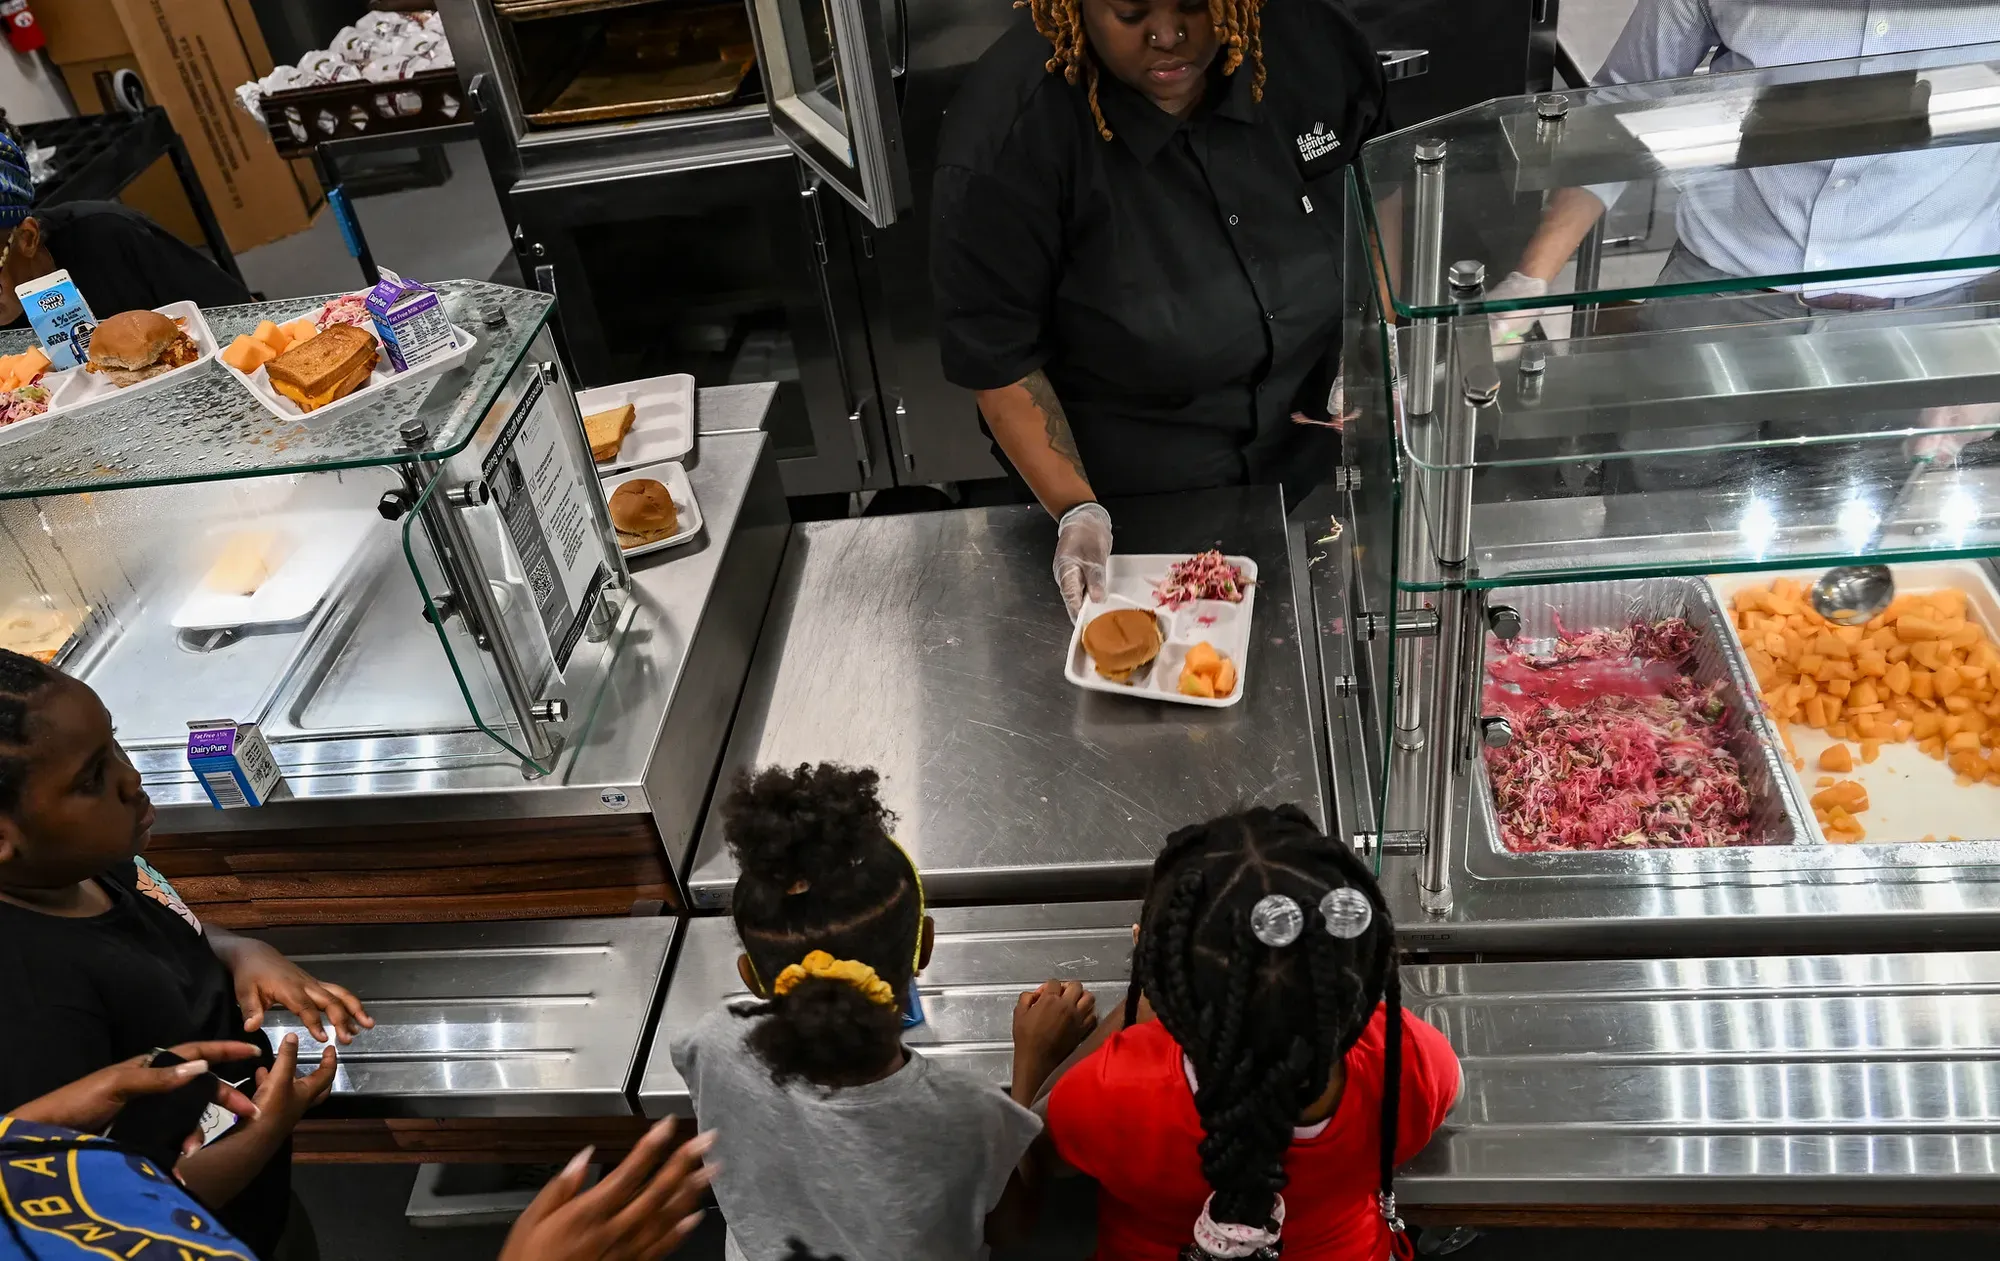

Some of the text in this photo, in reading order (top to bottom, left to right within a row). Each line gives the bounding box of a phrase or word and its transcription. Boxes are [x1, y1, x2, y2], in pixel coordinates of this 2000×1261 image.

[1296, 133, 1315, 146] d.c.
[1299, 129, 1337, 153] central
[1301, 140, 1341, 162] kitchen
[37, 294, 64, 308] Dairy
[41, 300, 65, 313] Pure
[51, 313, 69, 328] 1%
[389, 315, 398, 323] Fat
[396, 311, 408, 319] Free
[407, 305, 419, 314] Milk
[46, 335, 70, 347] WARS
[47, 331, 69, 341] STAR
[495, 442, 504, 456] up
[502, 437, 508, 446] a
[506, 418, 517, 439] Staff
[514, 403, 528, 426] Meal
[525, 380, 541, 409] Account
[190, 744, 228, 755] DairyPure
